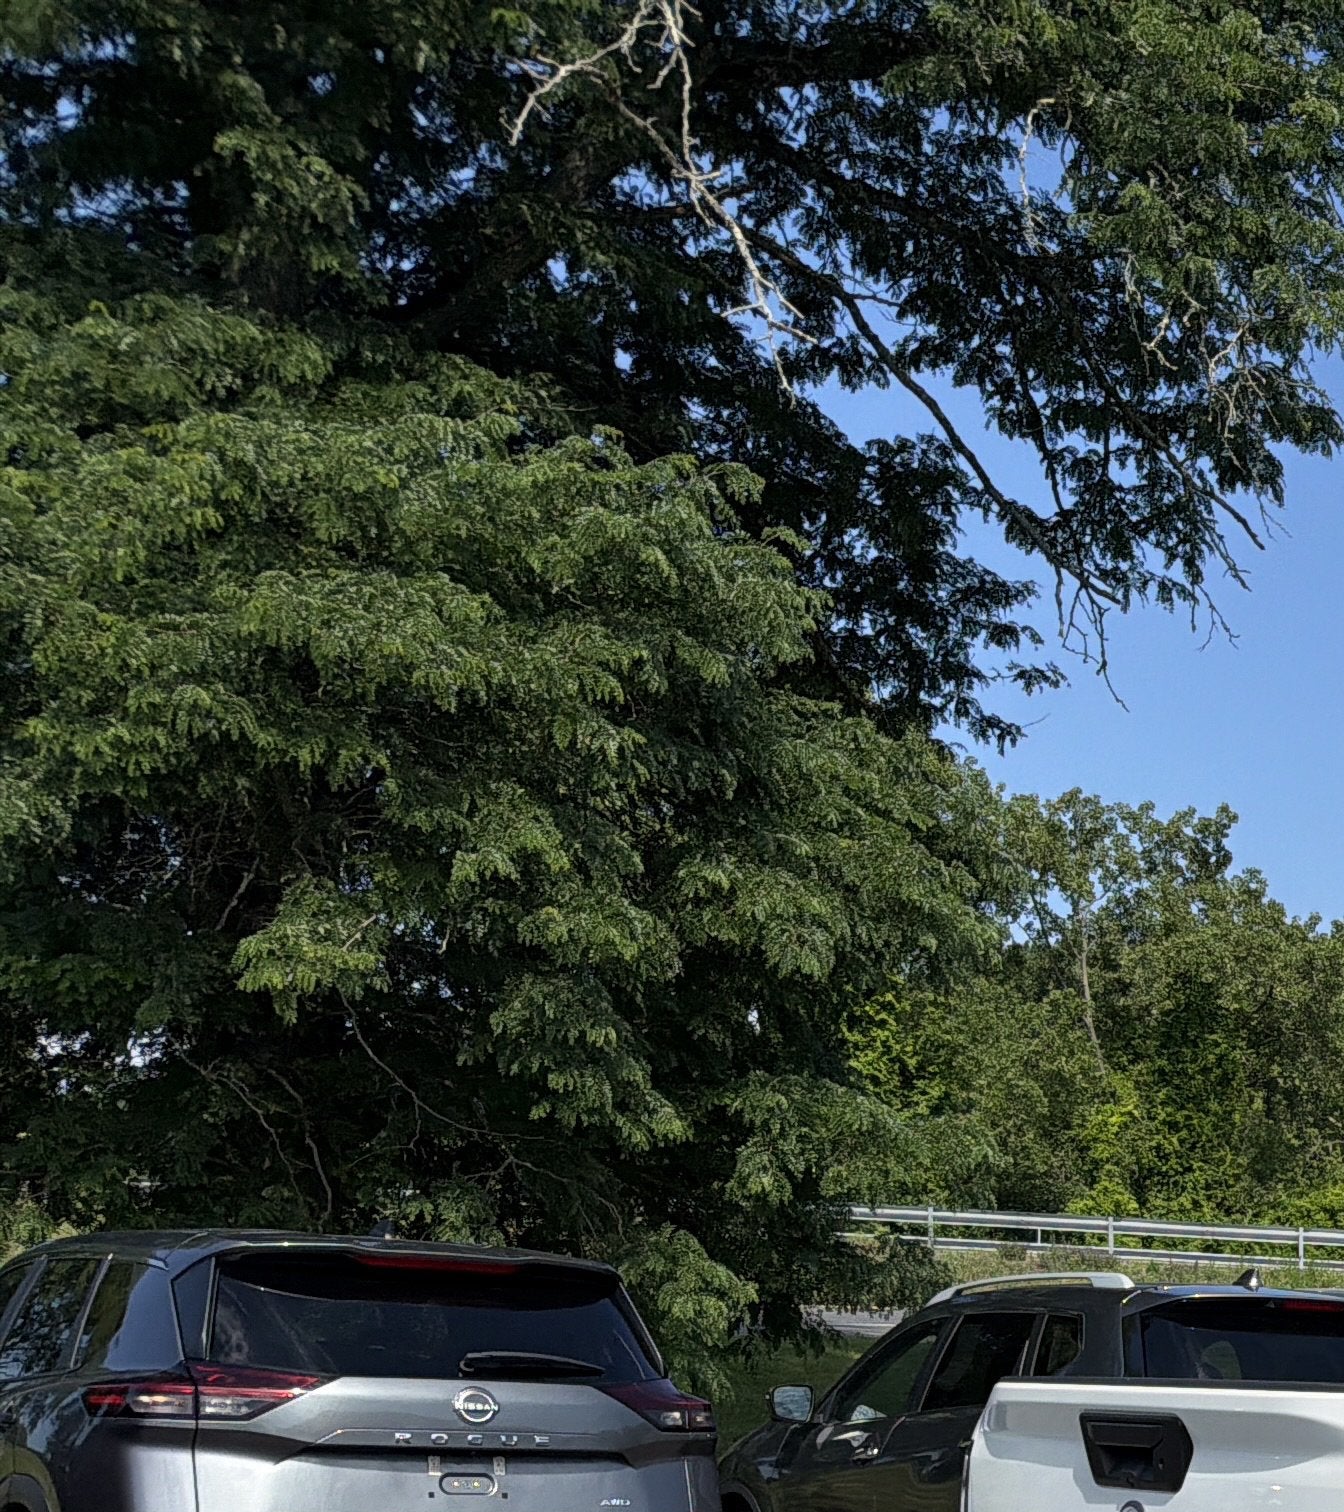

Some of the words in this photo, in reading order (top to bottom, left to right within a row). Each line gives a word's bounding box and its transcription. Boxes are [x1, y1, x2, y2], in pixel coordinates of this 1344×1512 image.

[454, 1401, 499, 1411] NISSAN
[394, 1432, 551, 1447] ROGUE
[600, 1498, 631, 1506] AWD
